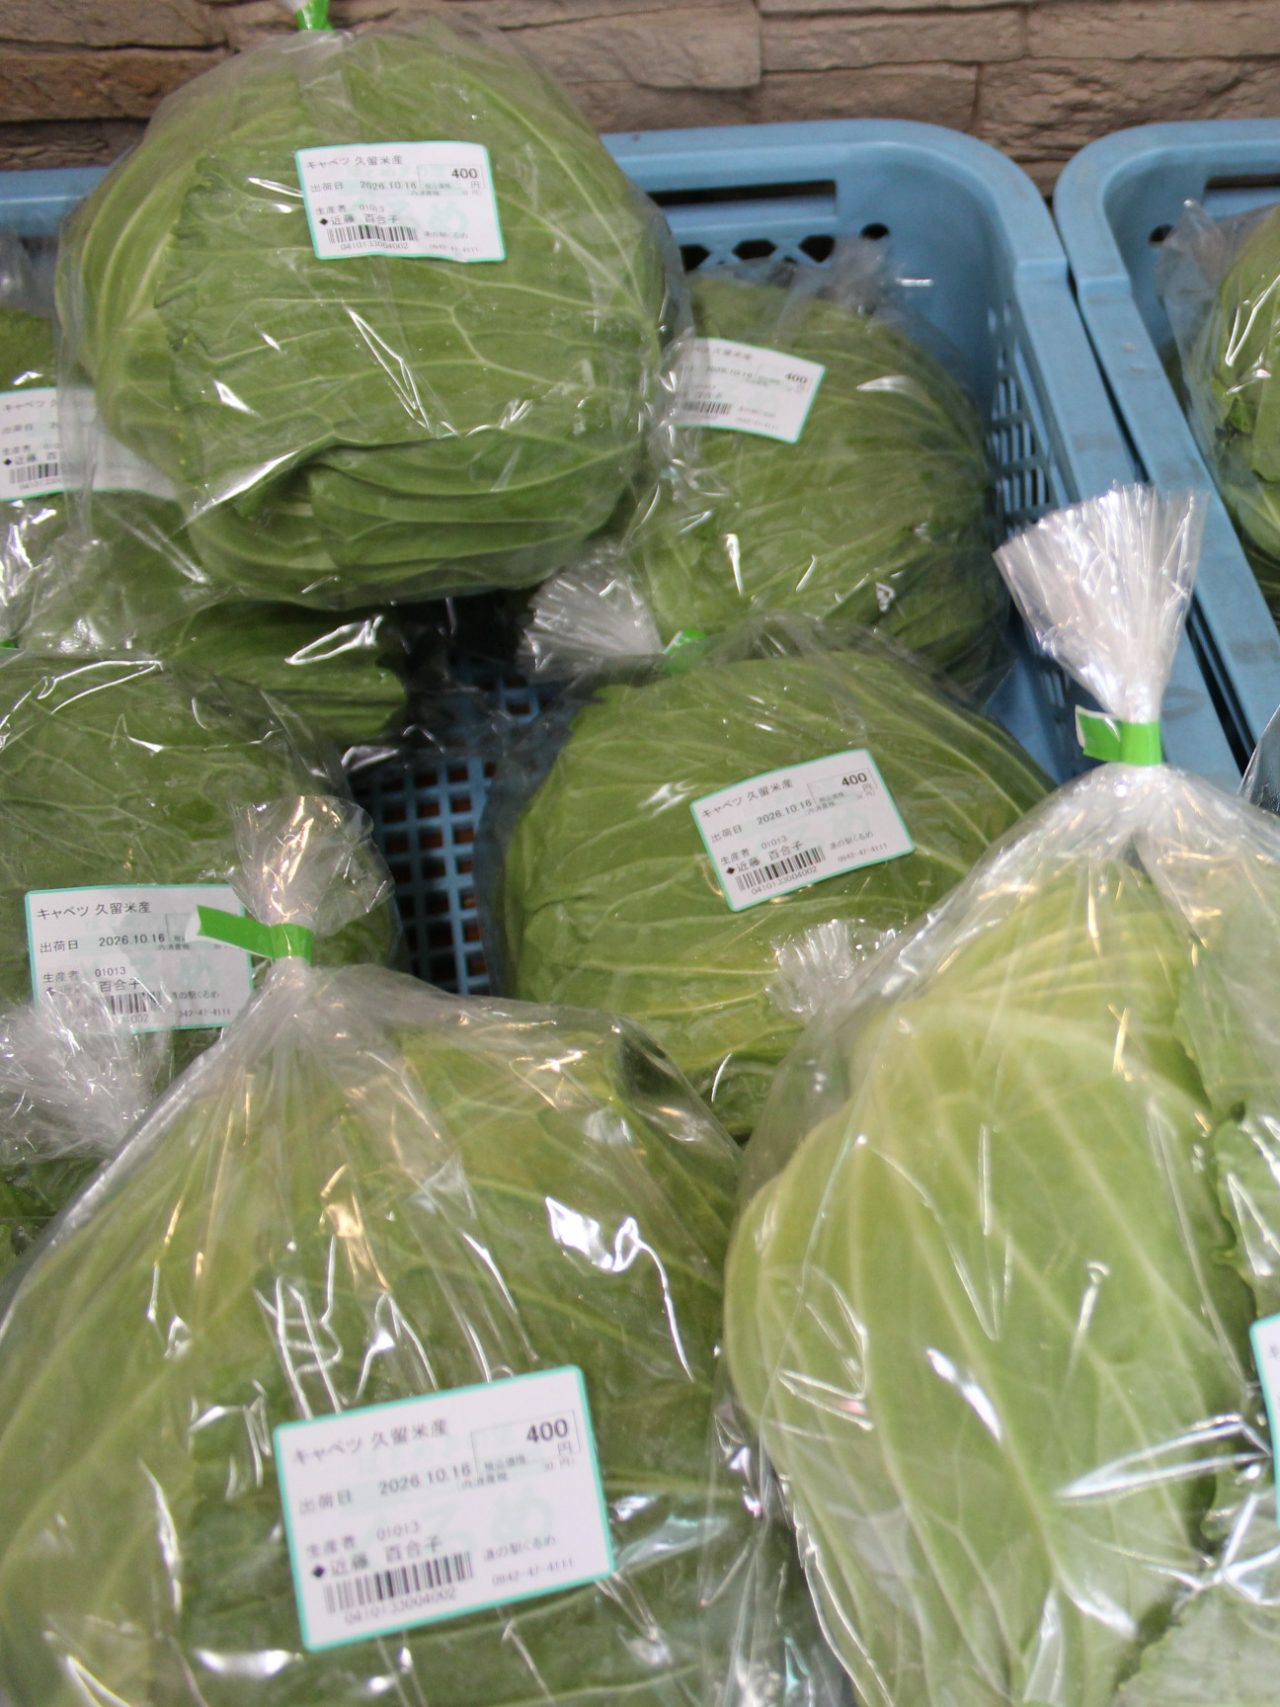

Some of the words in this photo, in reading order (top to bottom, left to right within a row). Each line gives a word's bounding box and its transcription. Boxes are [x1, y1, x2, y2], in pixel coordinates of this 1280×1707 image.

[306, 158, 350, 169] キャベツ
[355, 156, 403, 165] 久留米産
[452, 168, 478, 178] 400
[311, 183, 343, 191] 出荷日
[785, 372, 807, 383] 400
[841, 773, 868, 786] 400
[702, 796, 743, 817] キャベツ
[747, 780, 793, 801] 久留米産
[712, 826, 742, 841] 出荷日
[757, 801, 813, 823] 2026.10.16
[720, 850, 750, 863] 生産者
[761, 836, 787, 848] 01013
[737, 857, 760, 870] 近藤
[768, 842, 803, 859] 百合子
[37, 906, 89, 920] キャベツ
[95, 901, 151, 915] 久留米産
[40, 941, 79, 953] 出荷日
[99, 933, 165, 947] 2026.10.16
[95, 966, 126, 977] 01013
[526, 1419, 569, 1443] 400
[293, 1436, 364, 1464] キャベツ
[372, 1422, 448, 1450] 久留米産
[557, 1443, 572, 1455] 円
[301, 1491, 351, 1512] 出荷日
[379, 1463, 471, 1494] 2026.10.16
[307, 1535, 356, 1556] 生産者
[376, 1522, 420, 1539] 01013
[331, 1552, 368, 1575] 近藤
[385, 1536, 443, 1562] 百合子
